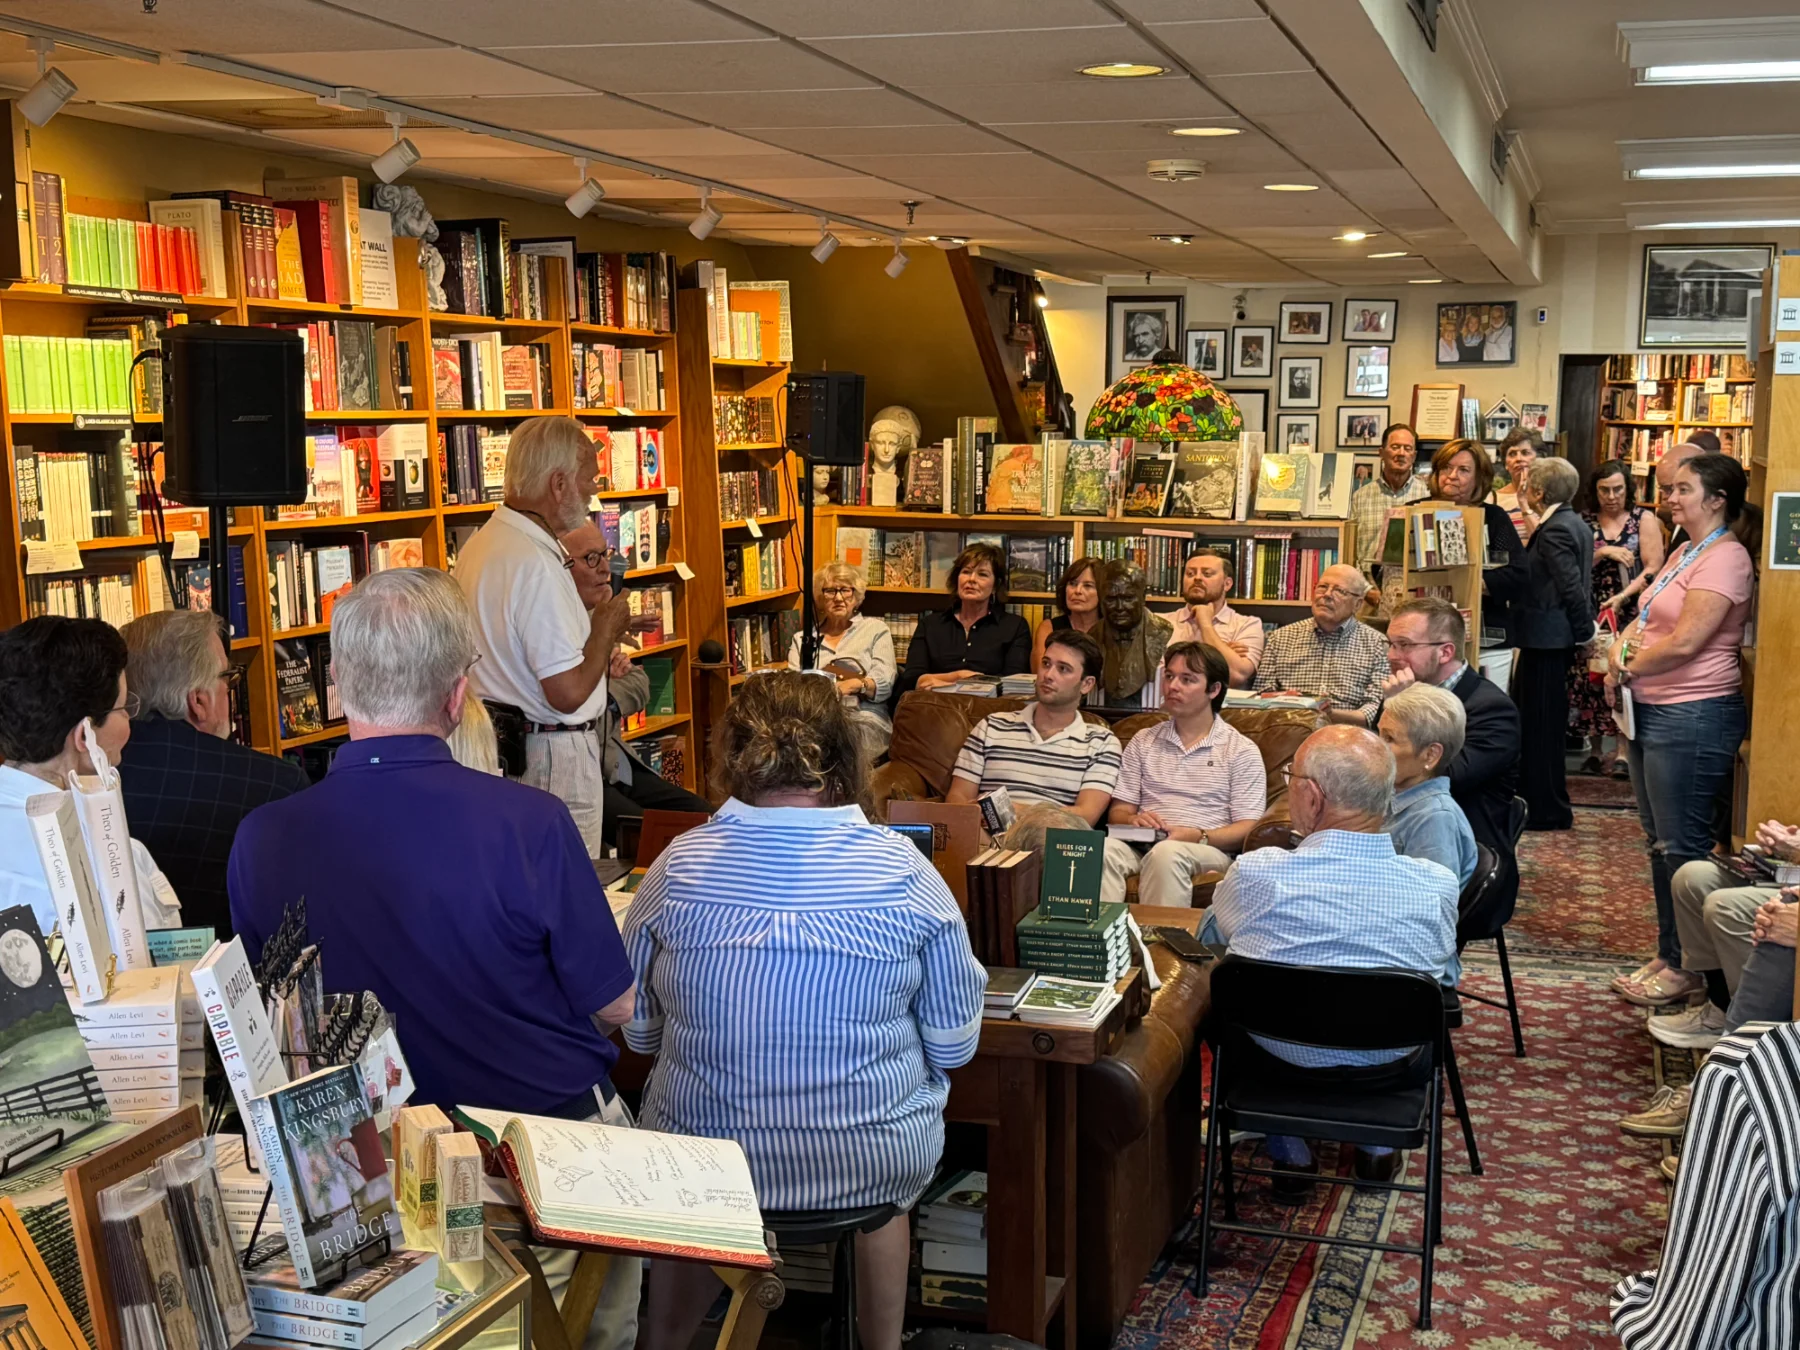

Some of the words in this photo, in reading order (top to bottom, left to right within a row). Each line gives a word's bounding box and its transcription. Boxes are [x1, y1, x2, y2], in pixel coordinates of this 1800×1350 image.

[167, 212, 192, 220] PLATO
[368, 242, 387, 252] WALL
[283, 260, 300, 270] THE
[1185, 454, 1229, 462] SANTORINI
[1011, 484, 1041, 492] NATURE
[276, 666, 308, 679] FEDERALIST
[285, 660, 297, 668] THE
[284, 675, 304, 686] PAPERS
[46, 827, 55, 849] Theo
[100, 804, 111, 832] Theo
[107, 842, 120, 878] Golden
[52, 850, 58, 858] of
[1062, 850, 1086, 858] KNIGHT
[53, 856, 66, 889] Golden
[1048, 896, 1069, 904] ETHAN
[1070, 897, 1092, 905] HAWKE
[122, 927, 132, 948] Allen
[75, 942, 84, 960] Allen
[80, 960, 88, 974] Levi
[125, 948, 135, 964] Levi
[225, 962, 252, 1010] CAPABLE
[207, 1004, 240, 1062] CAPABLE
[109, 1054, 128, 1062] Allen
[112, 1076, 130, 1084] Allen
[325, 1072, 349, 1084] BESTSELLER
[296, 1082, 346, 1114] KAREN
[282, 1097, 366, 1142] KINGSBURY
[256, 1114, 278, 1178] KINGSBURY
[268, 1126, 283, 1163] KAREN
[122, 1144, 154, 1168] FRANKLIN
[342, 1205, 364, 1222] THE
[280, 1184, 288, 1200] THE
[284, 1208, 305, 1262] BRIDGE
[320, 1211, 393, 1260] BRIDGE
[274, 1296, 288, 1305] THE
[294, 1298, 342, 1314] BRIDGE
[272, 1322, 286, 1330] THE
[290, 1324, 339, 1340] BRIDGE
